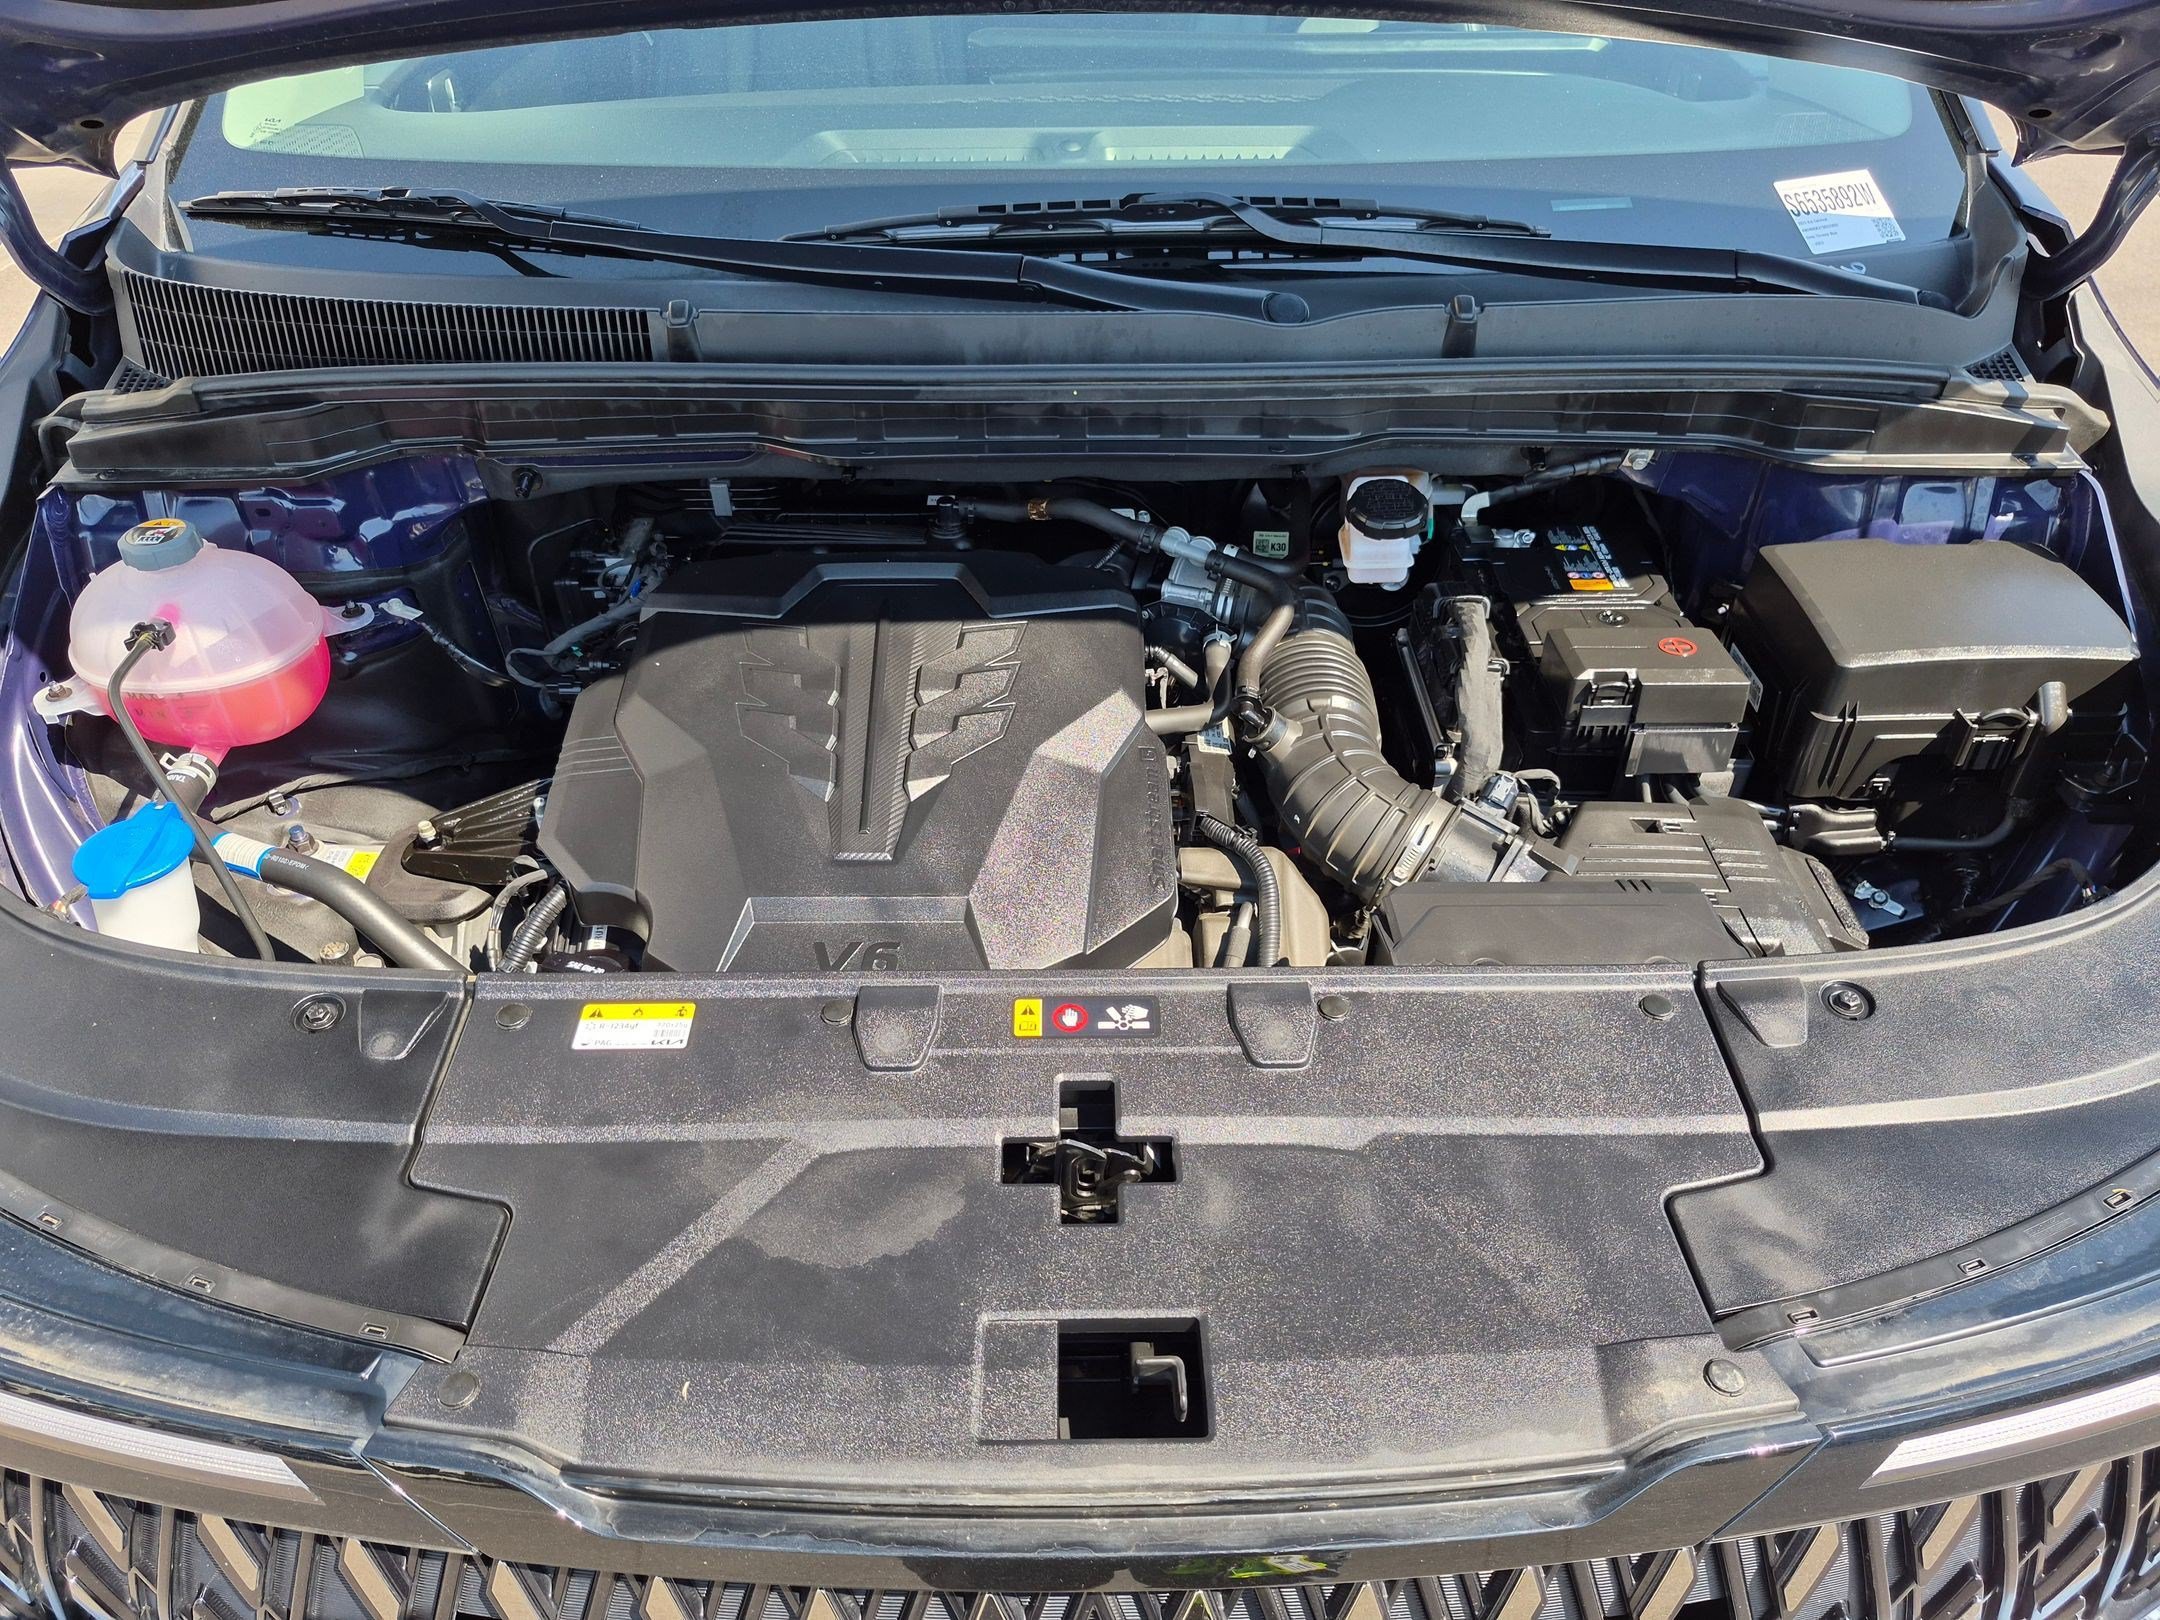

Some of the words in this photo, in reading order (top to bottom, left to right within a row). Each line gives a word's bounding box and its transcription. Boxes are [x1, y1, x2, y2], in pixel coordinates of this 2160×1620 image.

[1784, 182, 1876, 217] S6535892W
[1270, 543, 1287, 552] K30
[813, 941, 901, 971] V6
